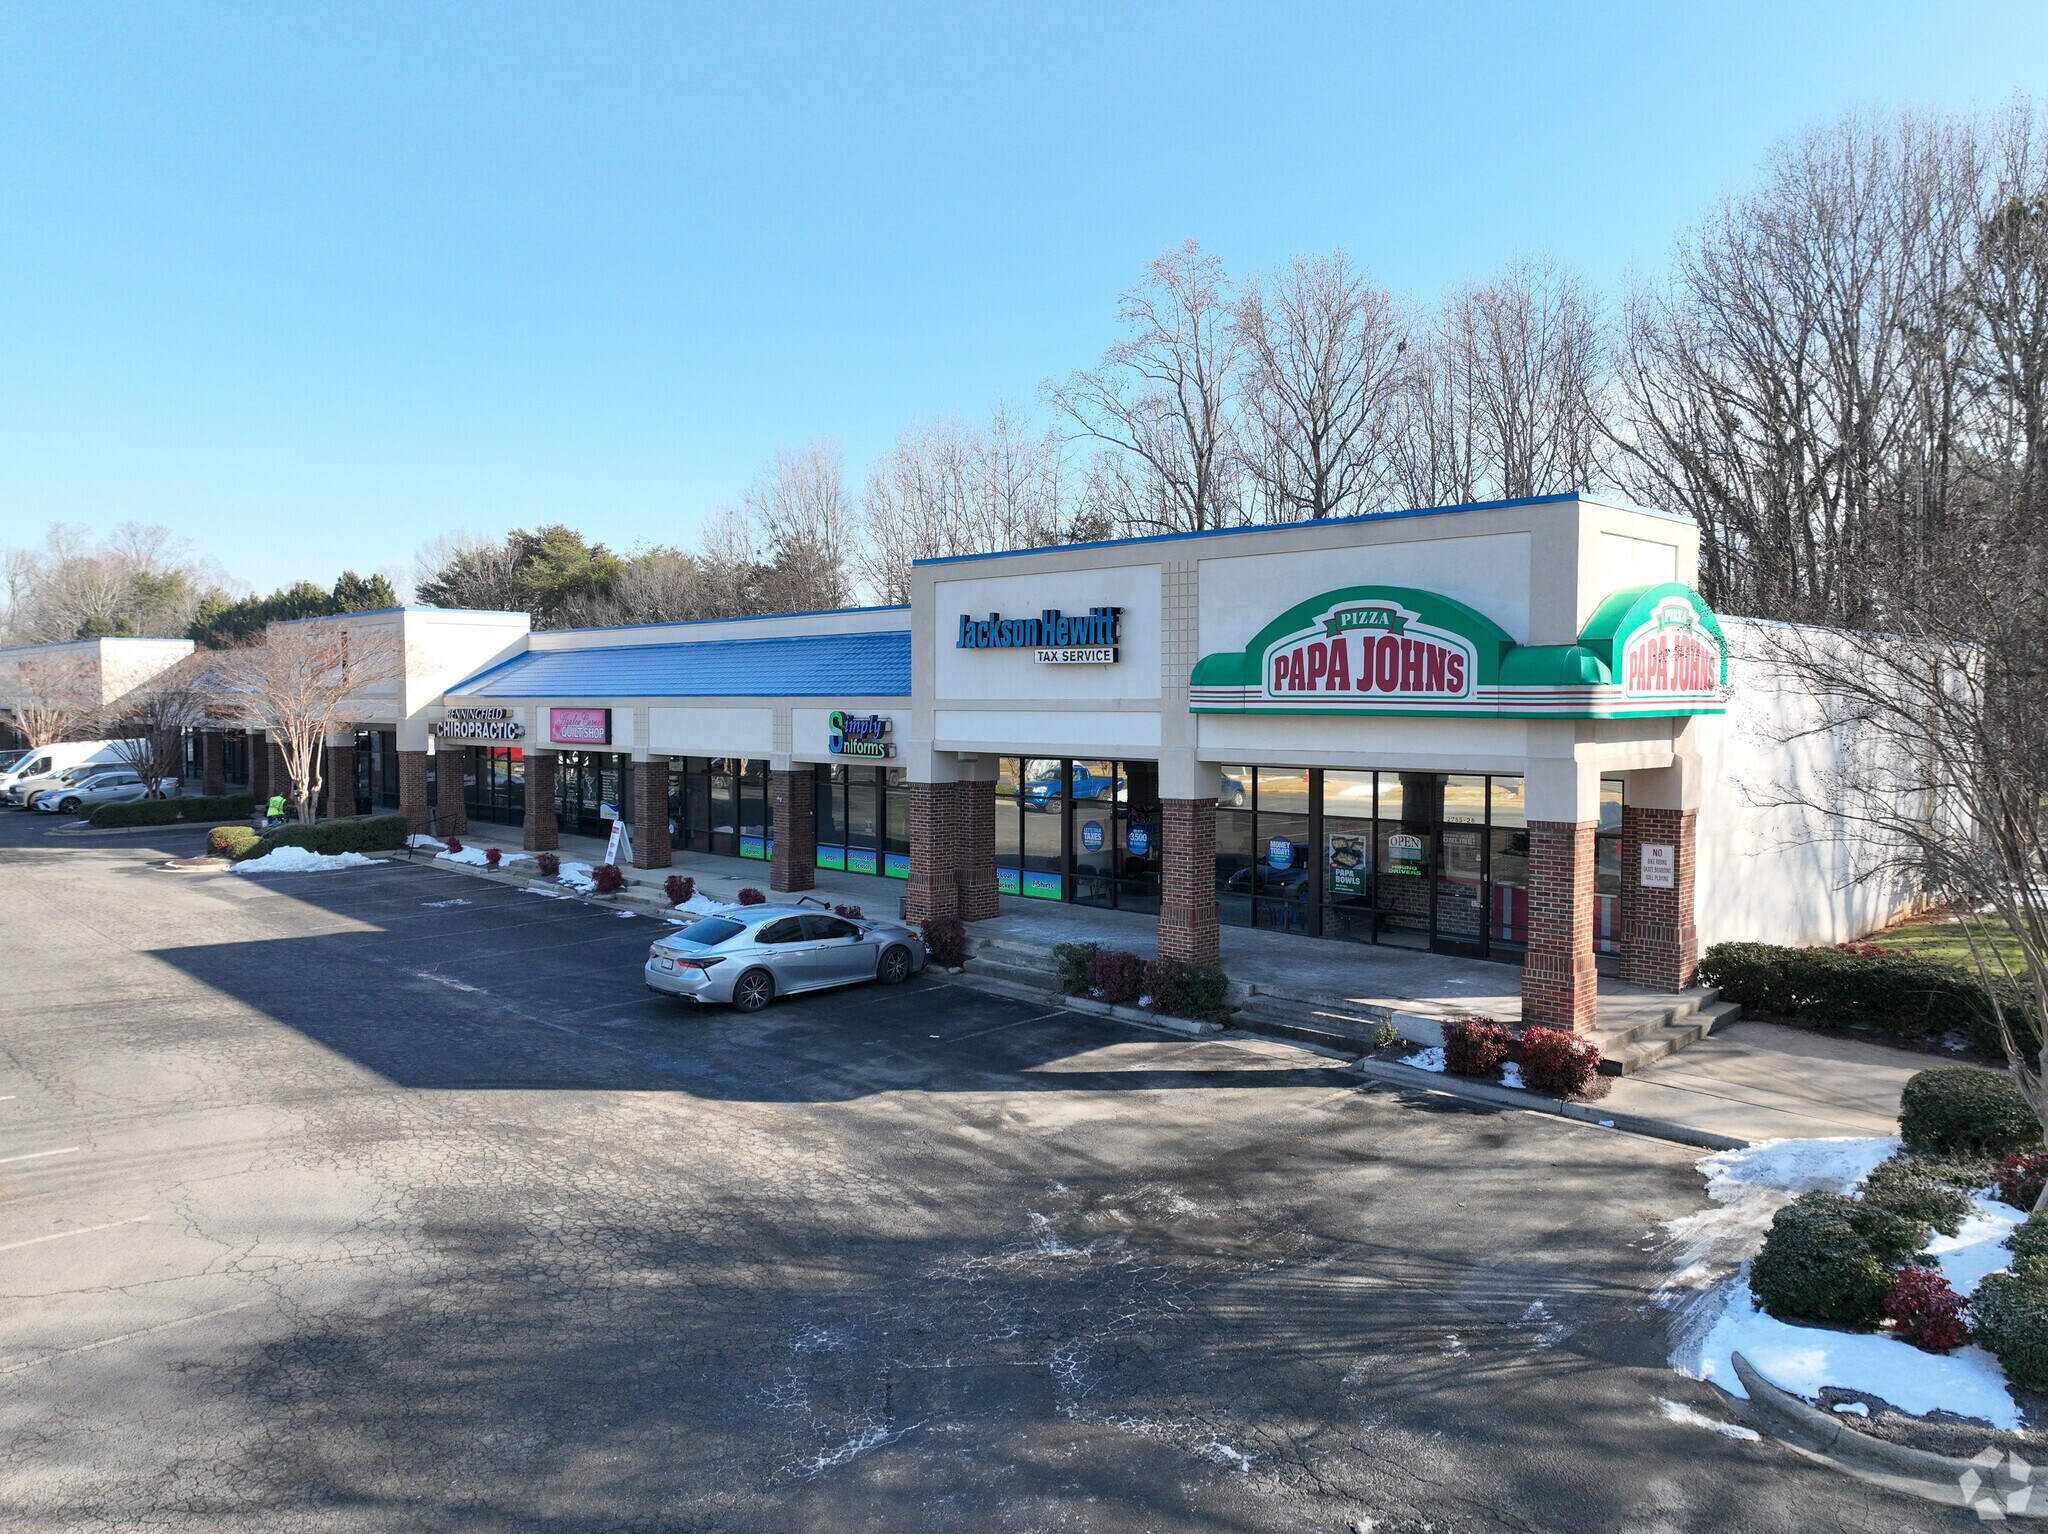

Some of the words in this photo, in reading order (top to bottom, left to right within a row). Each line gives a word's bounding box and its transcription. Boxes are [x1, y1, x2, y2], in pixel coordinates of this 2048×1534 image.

[1341, 611, 1389, 626] PIZZA
[1664, 608, 1688, 623] PIZZA
[956, 612, 1037, 648] Jackson
[1042, 607, 1114, 646] Hewitt
[1038, 651, 1058, 662] TAX
[1062, 650, 1111, 662] SERVICE
[1274, 638, 1350, 691] PAPA
[1356, 636, 1464, 692] JOHN'S
[1628, 635, 1668, 691] PAPA
[436, 721, 516, 740] CHIROPRACTIC
[829, 711, 882, 740] Simply
[561, 726, 583, 738] QUILT
[583, 727, 605, 739] SHOP
[1083, 832, 1102, 841] TAXES
[1390, 836, 1420, 848] OPEN
[1443, 837, 1476, 845] ONLINE!
[1270, 840, 1290, 849] MONEY
[1270, 847, 1290, 856] TODAY!
[1652, 848, 1663, 857] NO
[1335, 868, 1354, 877] PAPA
[1388, 868, 1422, 876] DRIVERS
[999, 881, 1016, 890] ackets
[1031, 880, 1054, 890] T-Shirts
[1335, 875, 1361, 885] BOWLS
